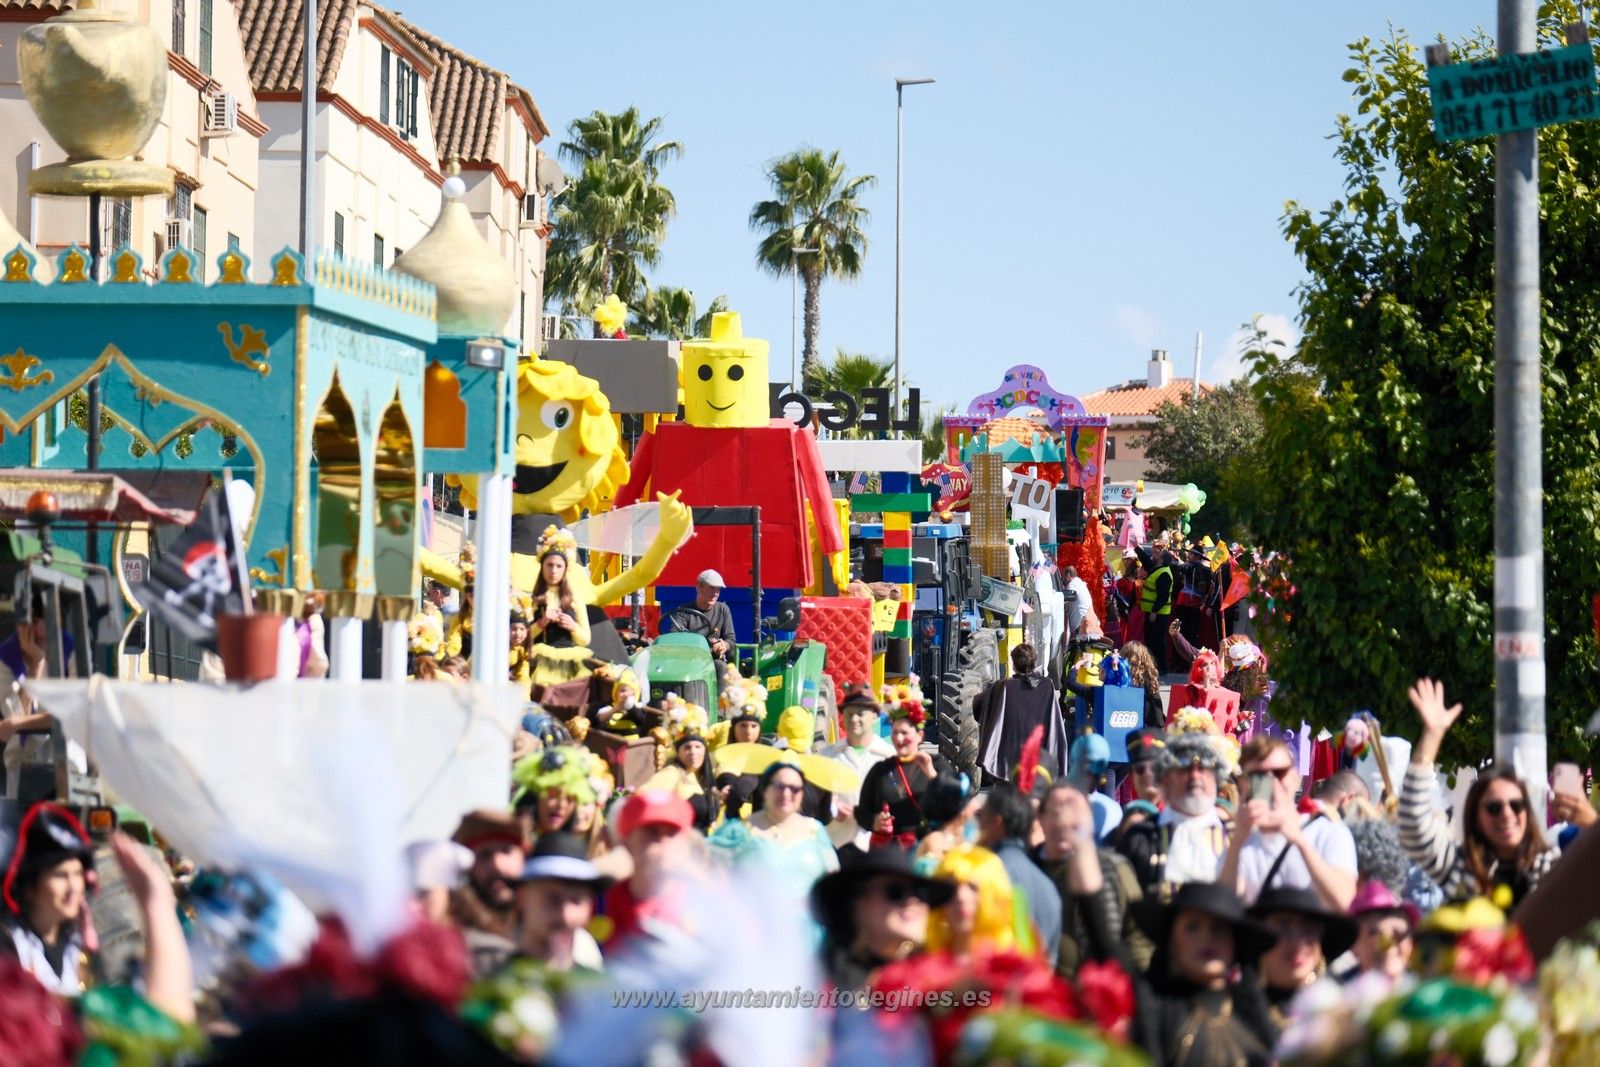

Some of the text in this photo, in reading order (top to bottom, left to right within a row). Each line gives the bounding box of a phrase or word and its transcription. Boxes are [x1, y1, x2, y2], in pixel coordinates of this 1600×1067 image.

[1440, 79, 1454, 101] A
[1001, 389, 1051, 408] COCO
[1110, 711, 1138, 727] LEGO
